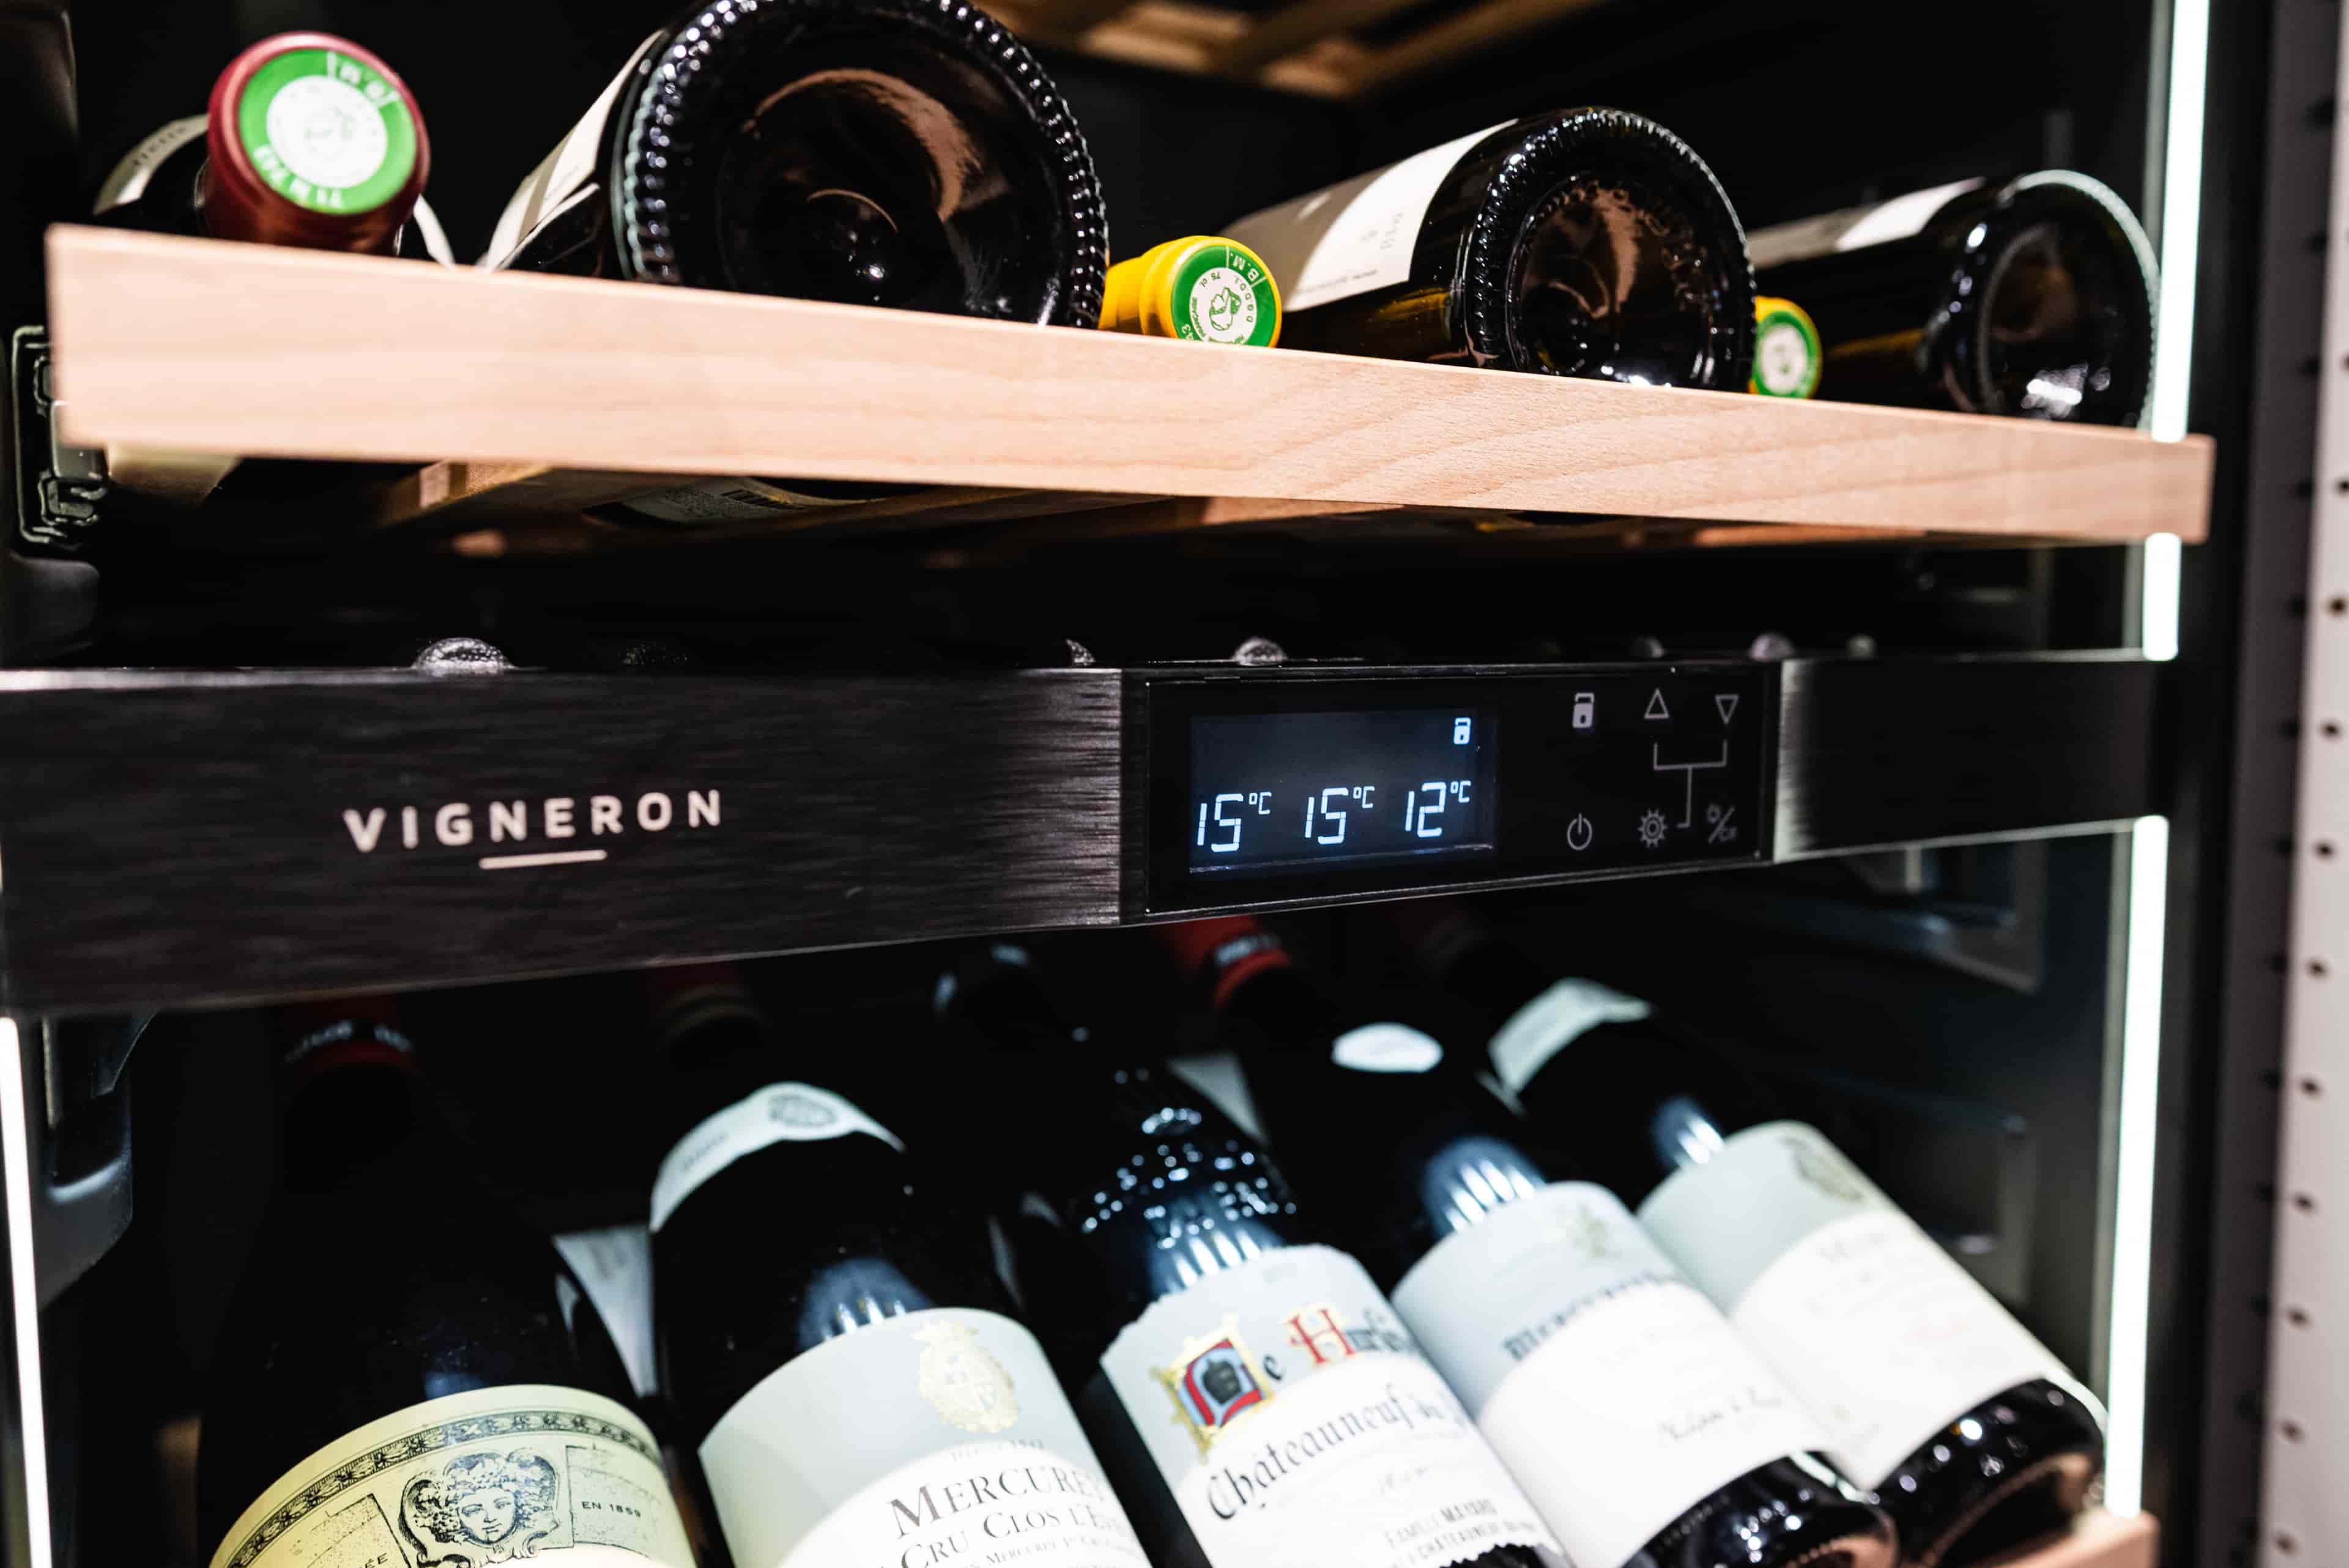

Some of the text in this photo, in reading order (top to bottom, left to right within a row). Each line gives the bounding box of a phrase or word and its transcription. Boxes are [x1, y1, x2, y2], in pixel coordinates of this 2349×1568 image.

[344, 789, 721, 852] VIGNERON
[582, 1501, 603, 1510] EN
[900, 1530, 970, 1568] CRU
